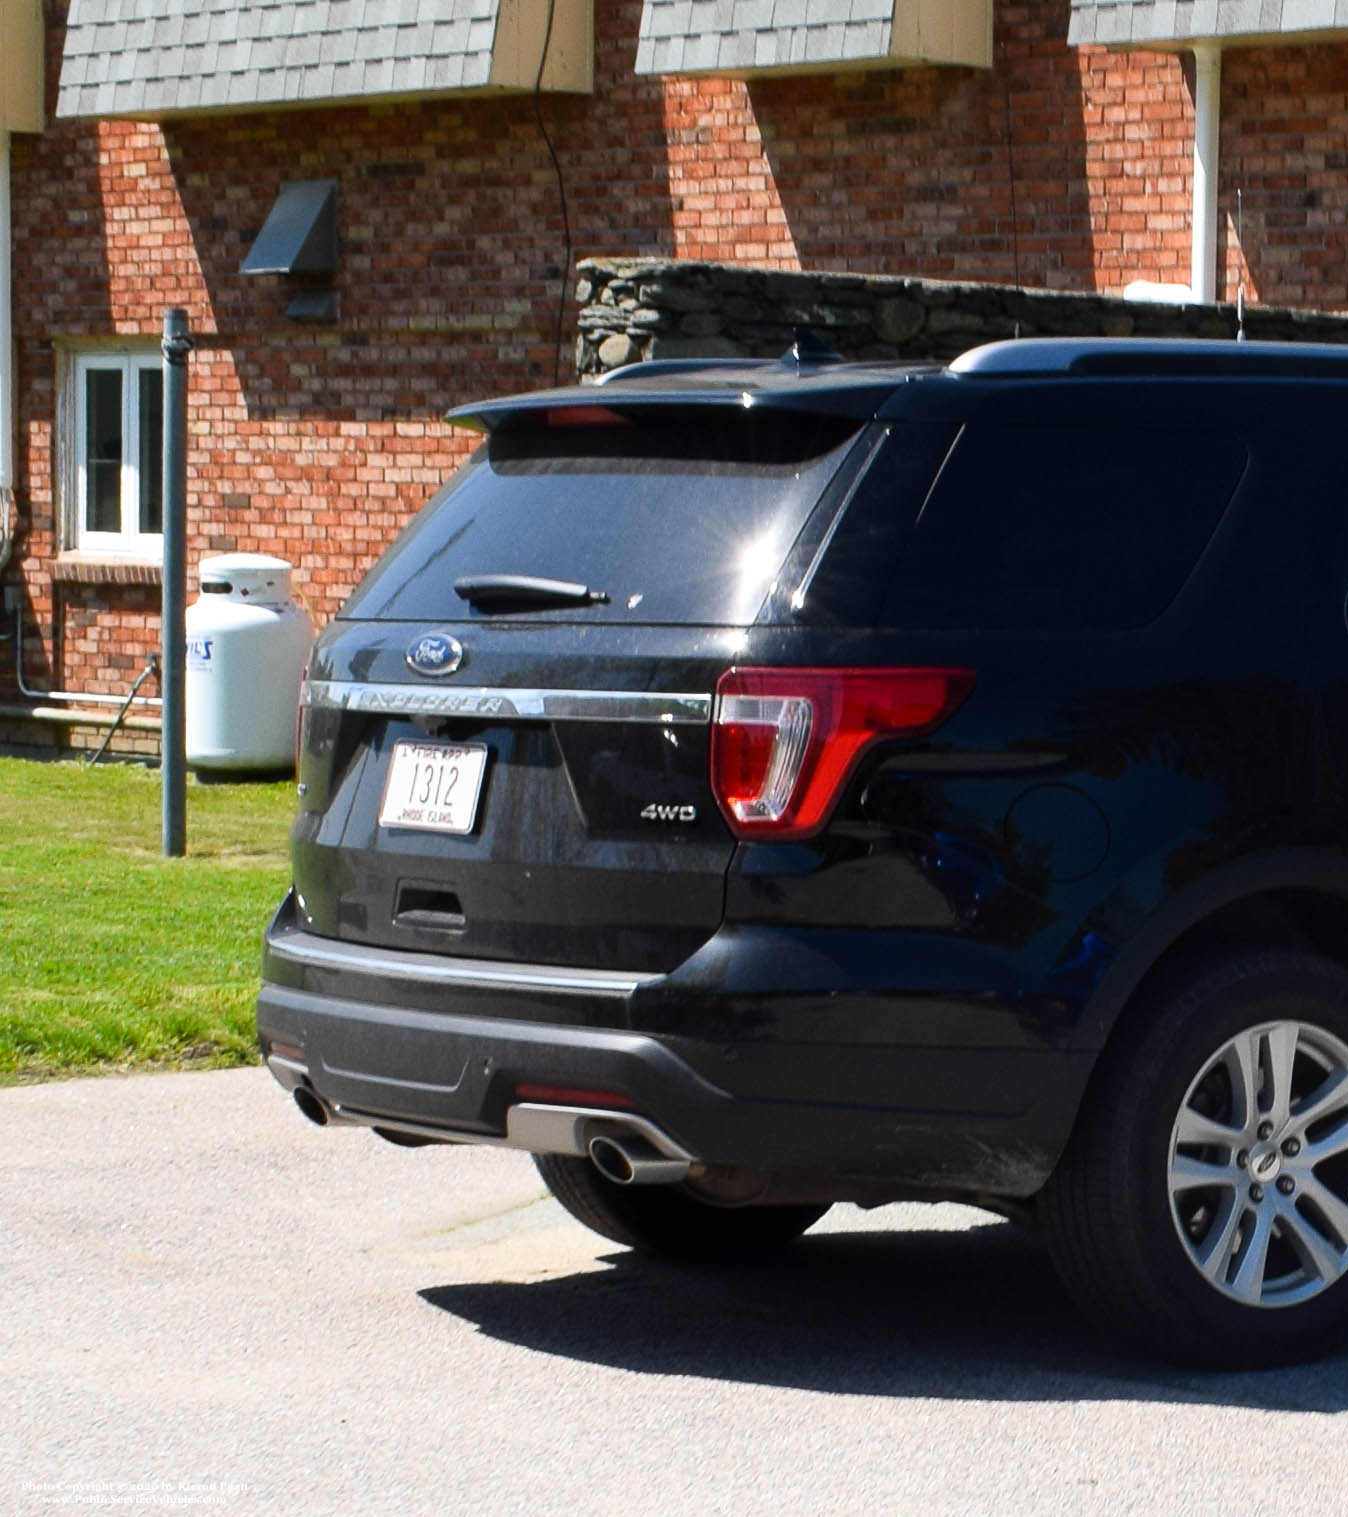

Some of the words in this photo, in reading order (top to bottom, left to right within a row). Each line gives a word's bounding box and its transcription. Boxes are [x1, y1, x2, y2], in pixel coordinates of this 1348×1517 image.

[415, 638, 447, 664] Ford
[409, 763, 459, 806] 1312
[640, 803, 696, 821] 4WD
